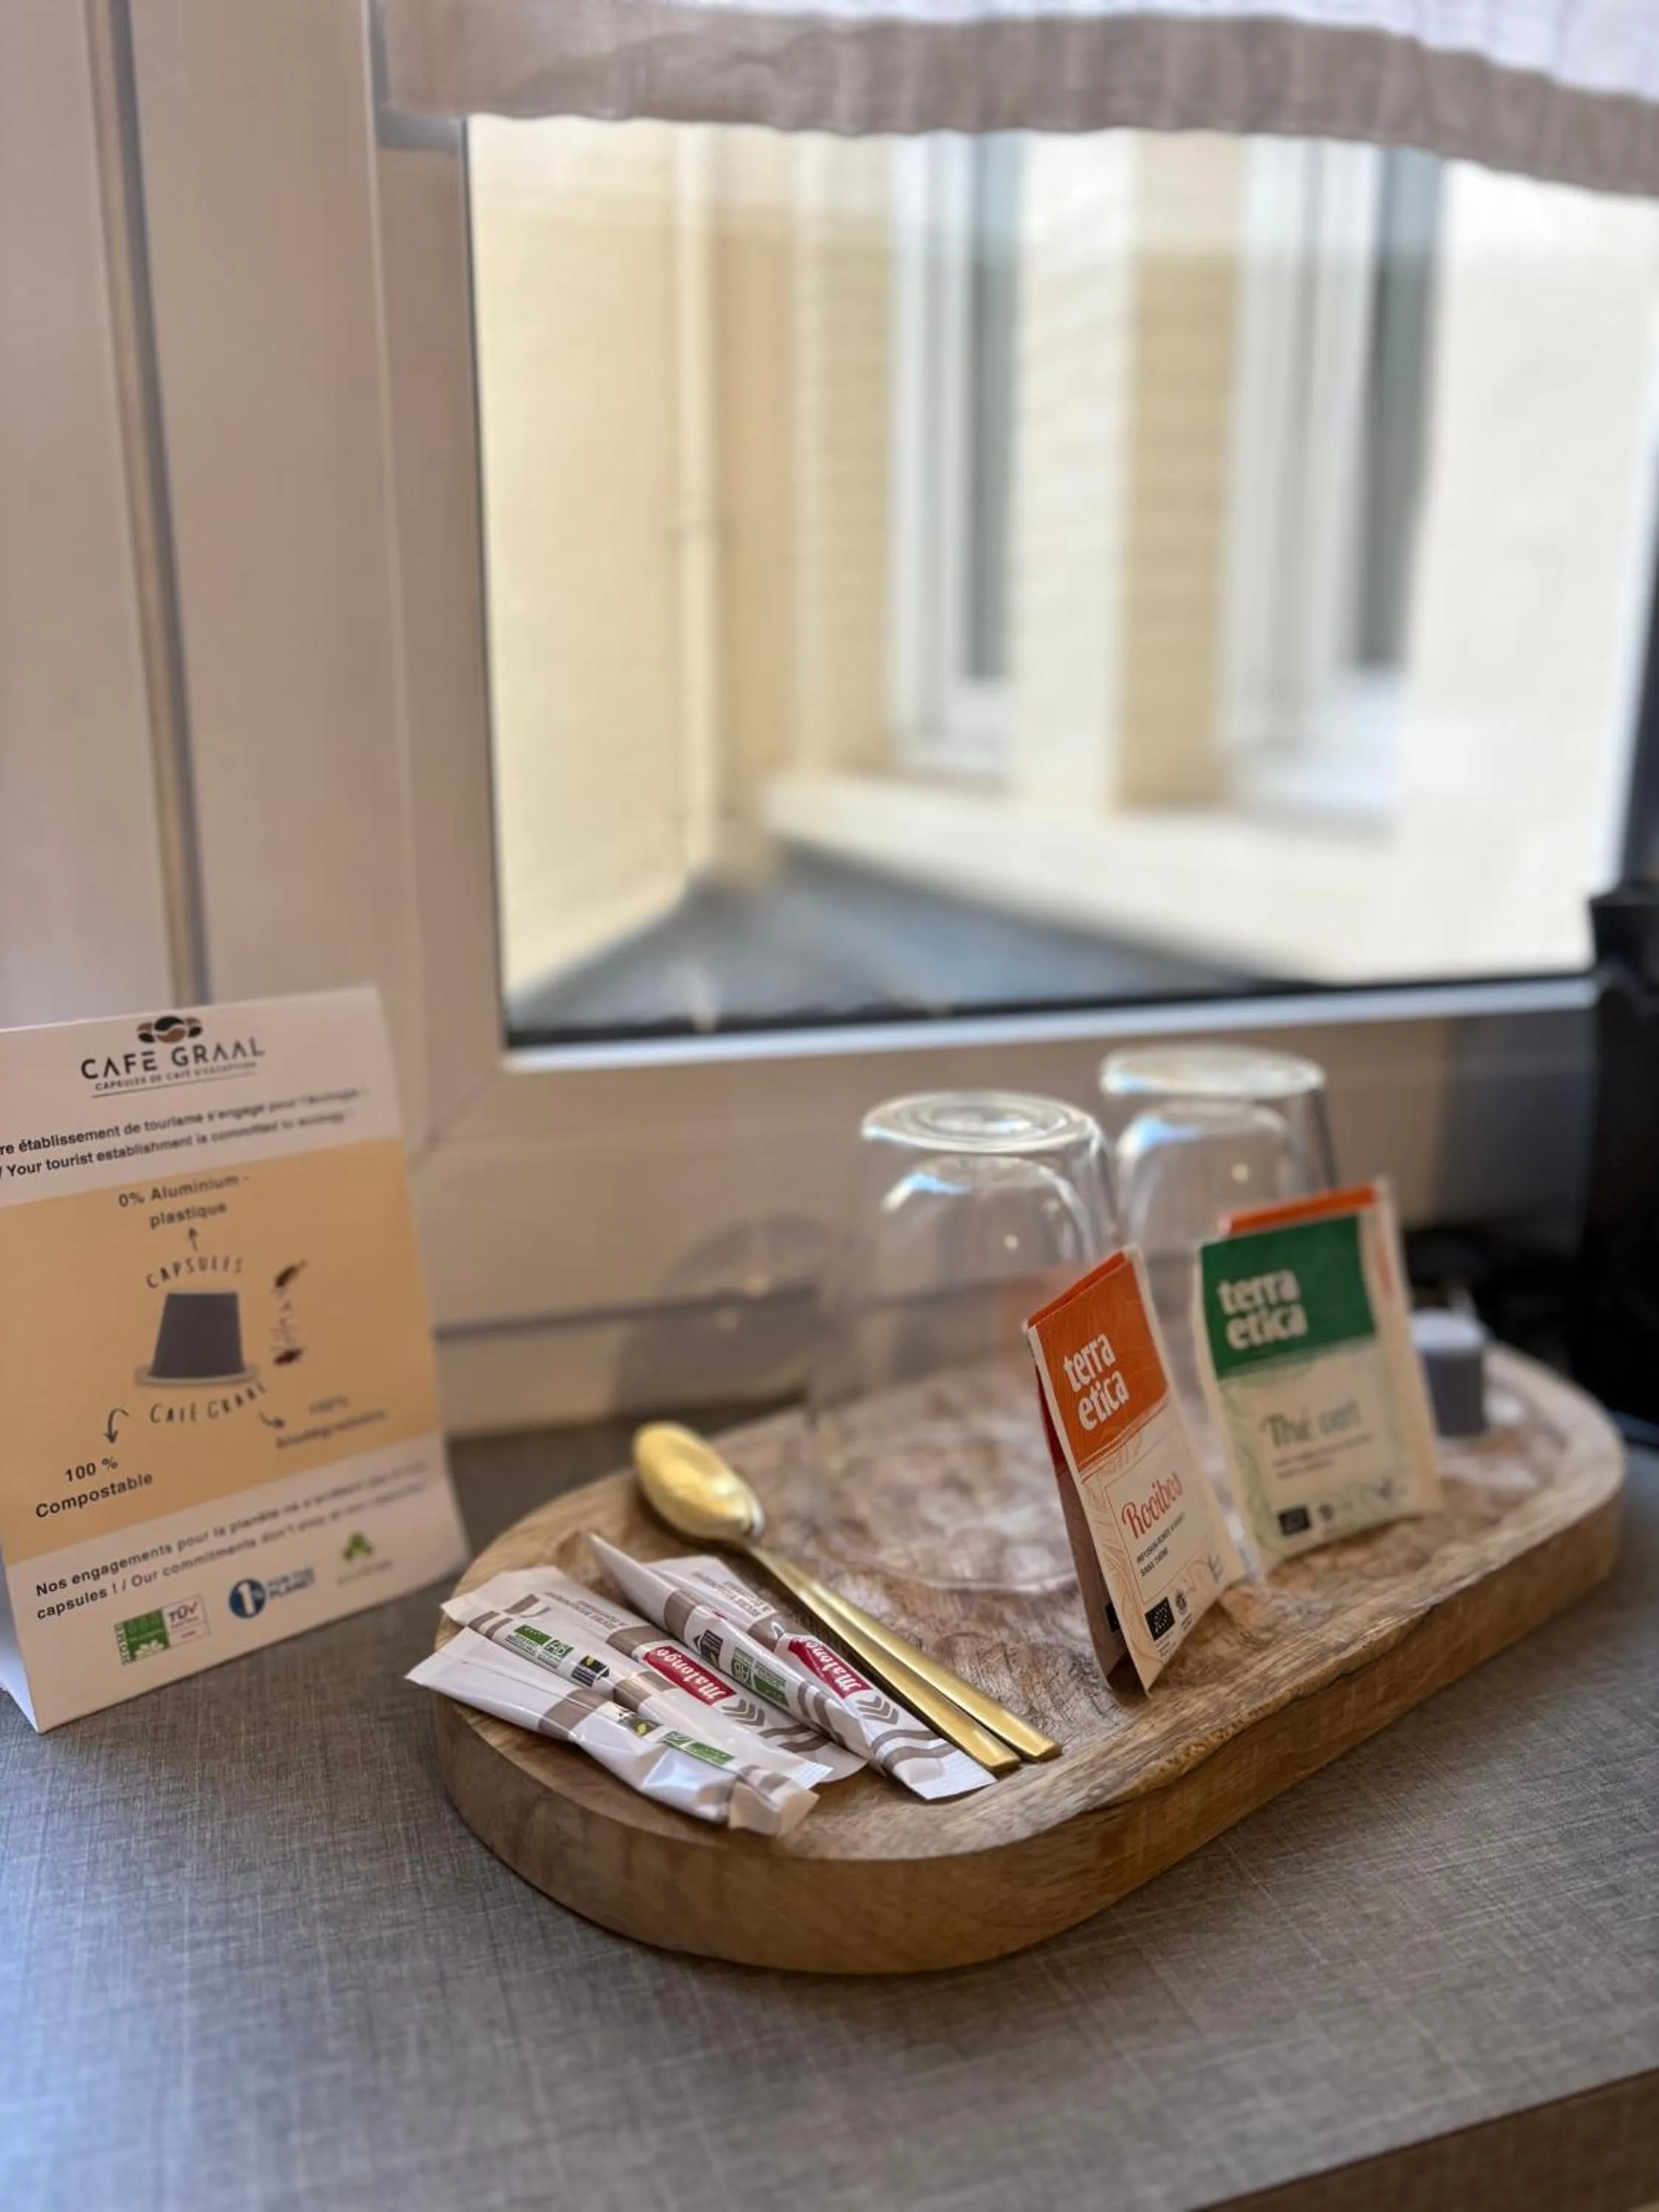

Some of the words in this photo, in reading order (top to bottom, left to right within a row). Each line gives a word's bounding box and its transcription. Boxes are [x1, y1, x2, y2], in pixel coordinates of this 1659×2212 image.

[170, 1036, 265, 1066] GRAAL
[18, 1125, 120, 1153] établissement
[124, 1122, 141, 1134] de
[144, 1113, 204, 1132] tourisme
[6, 1162, 42, 1178] Your
[46, 1152, 94, 1171] tourist
[96, 1134, 193, 1162] establishment
[118, 1192, 145, 1208] 0%
[151, 1175, 240, 1202] Aluminium
[150, 1202, 227, 1231] plastique
[1217, 1268, 1301, 1315] terra
[1226, 1304, 1309, 1349] etica
[1063, 1333, 1116, 1392] terra
[1079, 1371, 1130, 1430] etica
[65, 1462, 97, 1483] 100
[35, 1473, 153, 1519] Compostable
[36, 1577, 68, 1597] Nos
[72, 1543, 173, 1585] engagements
[177, 1531, 209, 1553] pour
[37, 1587, 108, 1621] capsules
[131, 1570, 159, 1587] Our
[655, 1648, 726, 1700] Malongo
